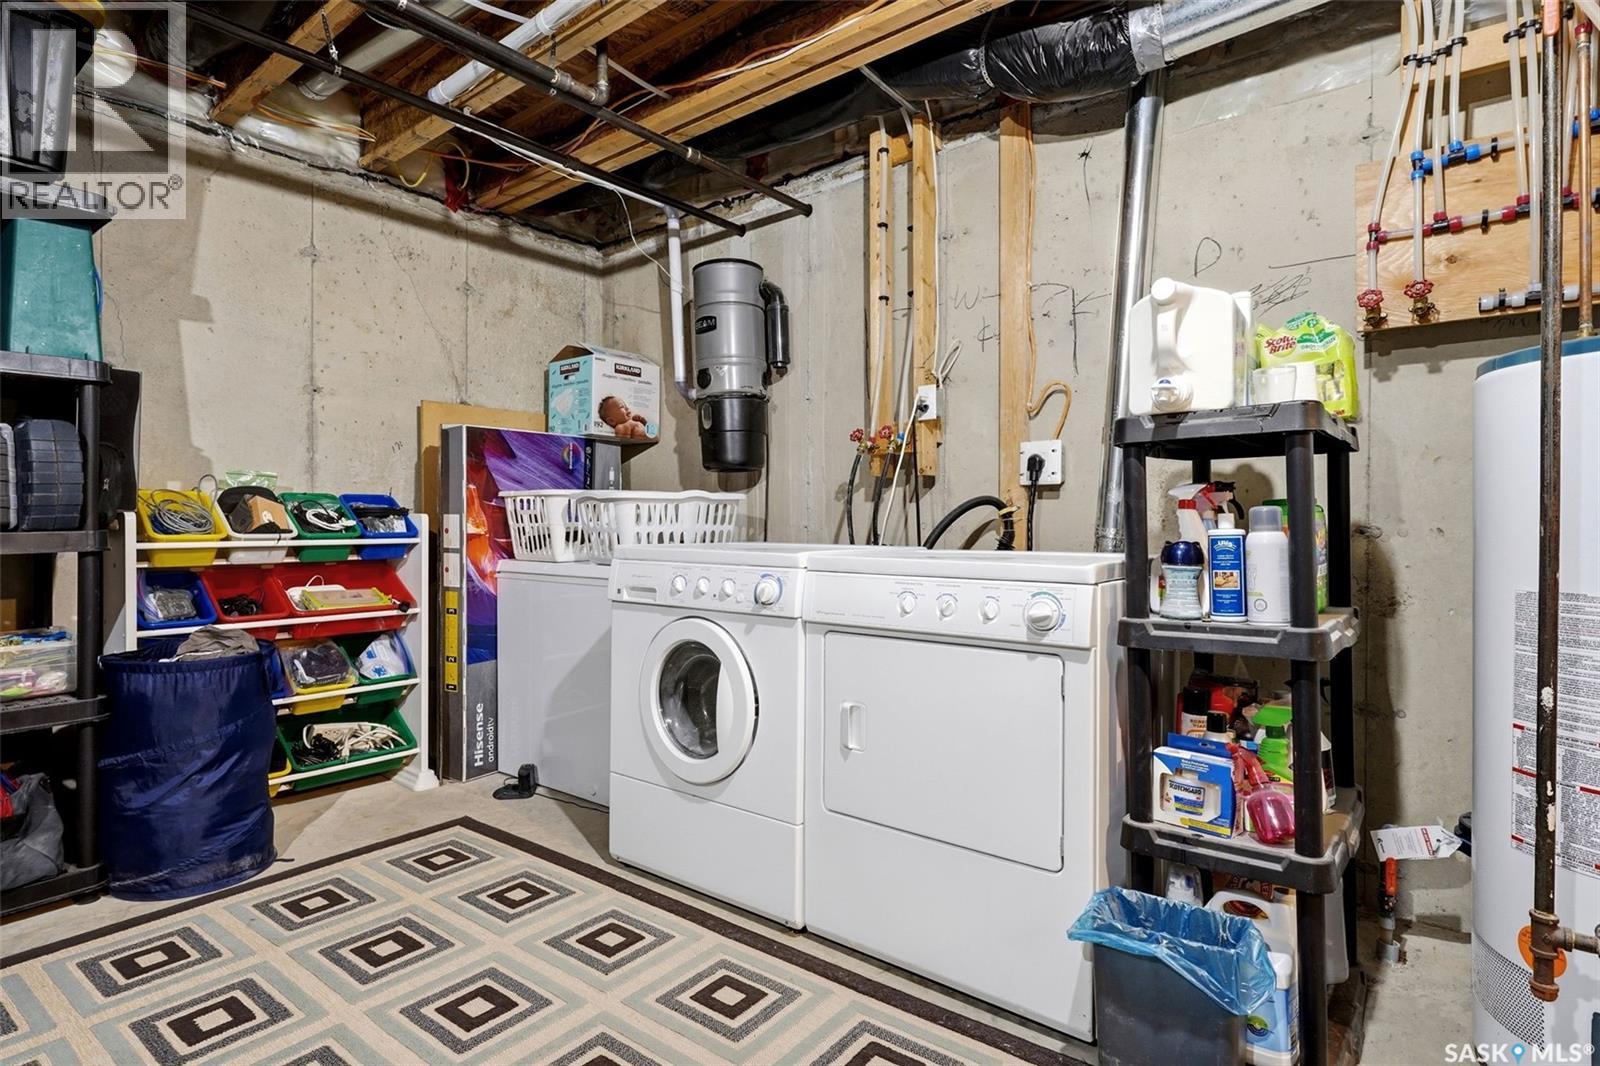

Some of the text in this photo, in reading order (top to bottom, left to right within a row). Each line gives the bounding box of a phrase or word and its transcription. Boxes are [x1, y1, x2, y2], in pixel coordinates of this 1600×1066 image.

[615, 363, 641, 374] KIRKLAND
[474, 703, 484, 767] Hisense
[1169, 782, 1202, 796] SCOTCHGARD
